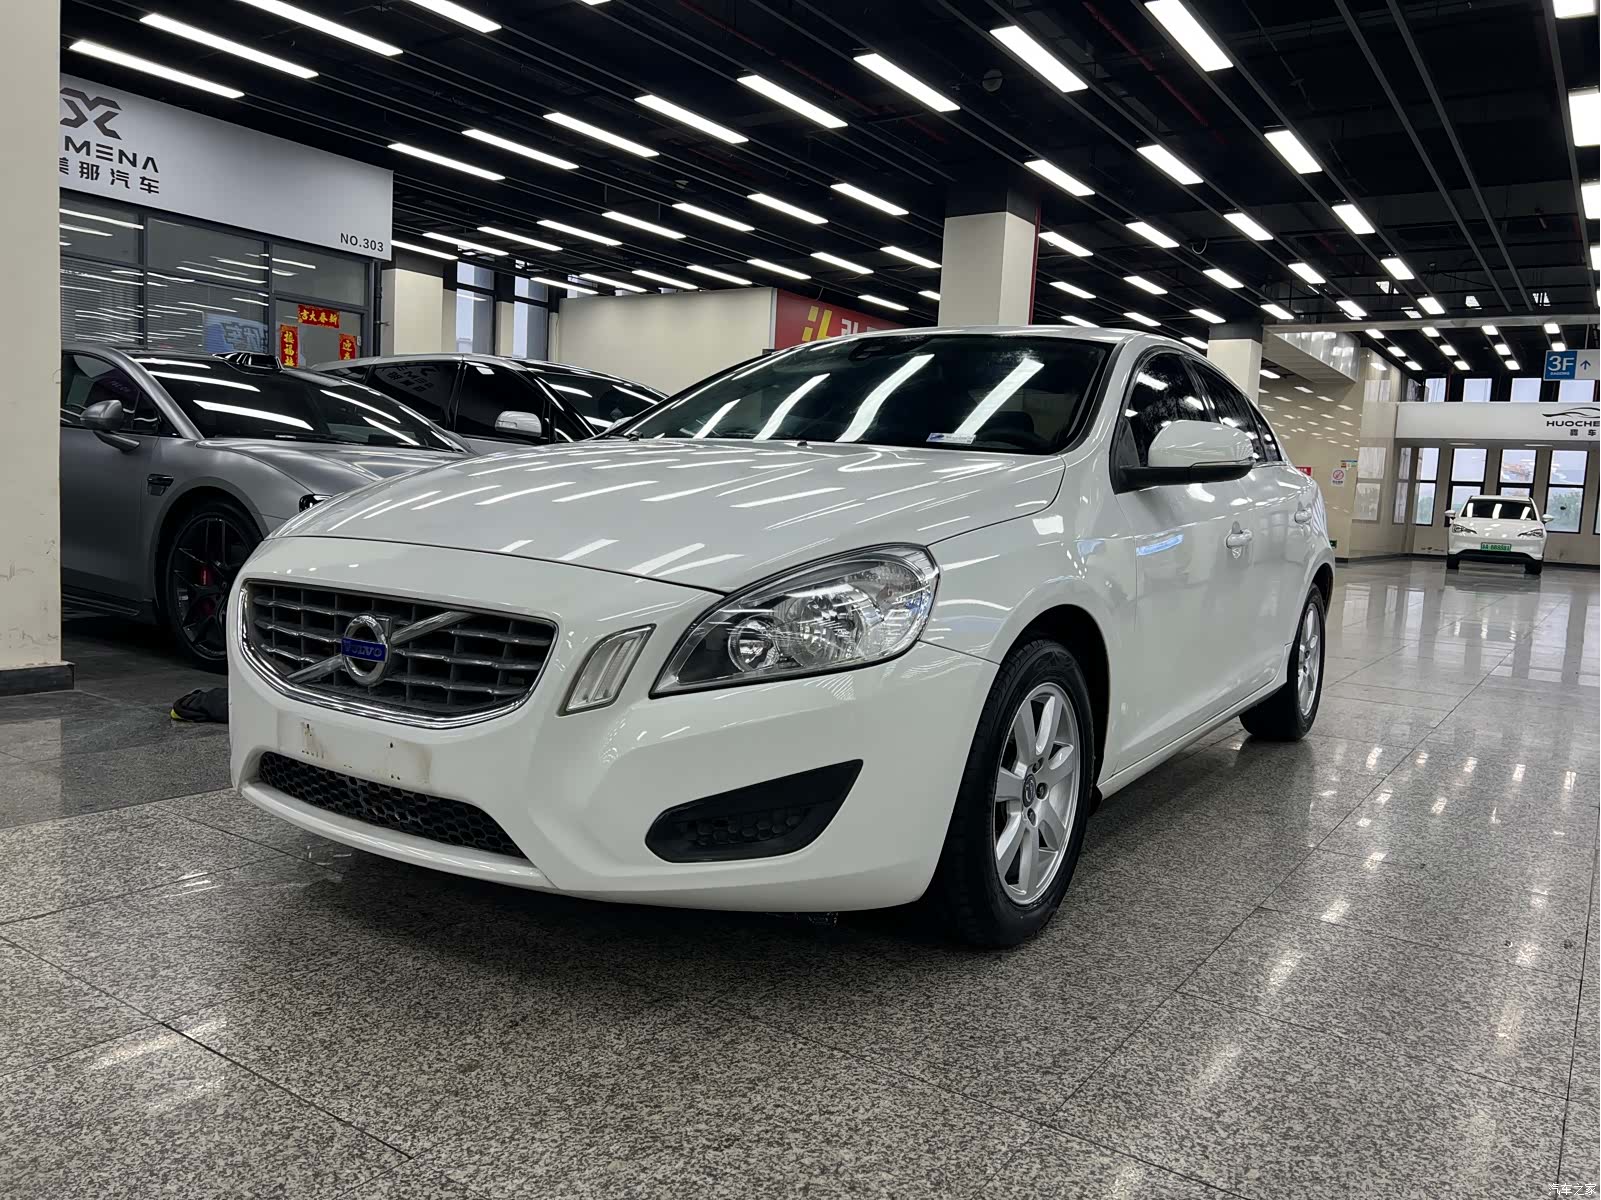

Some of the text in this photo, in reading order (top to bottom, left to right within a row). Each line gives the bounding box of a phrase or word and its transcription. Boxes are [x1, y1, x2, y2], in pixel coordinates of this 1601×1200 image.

[340, 232, 385, 253] NO.303
[1548, 355, 1575, 371] 3F
[342, 639, 382, 657] VOLVO
